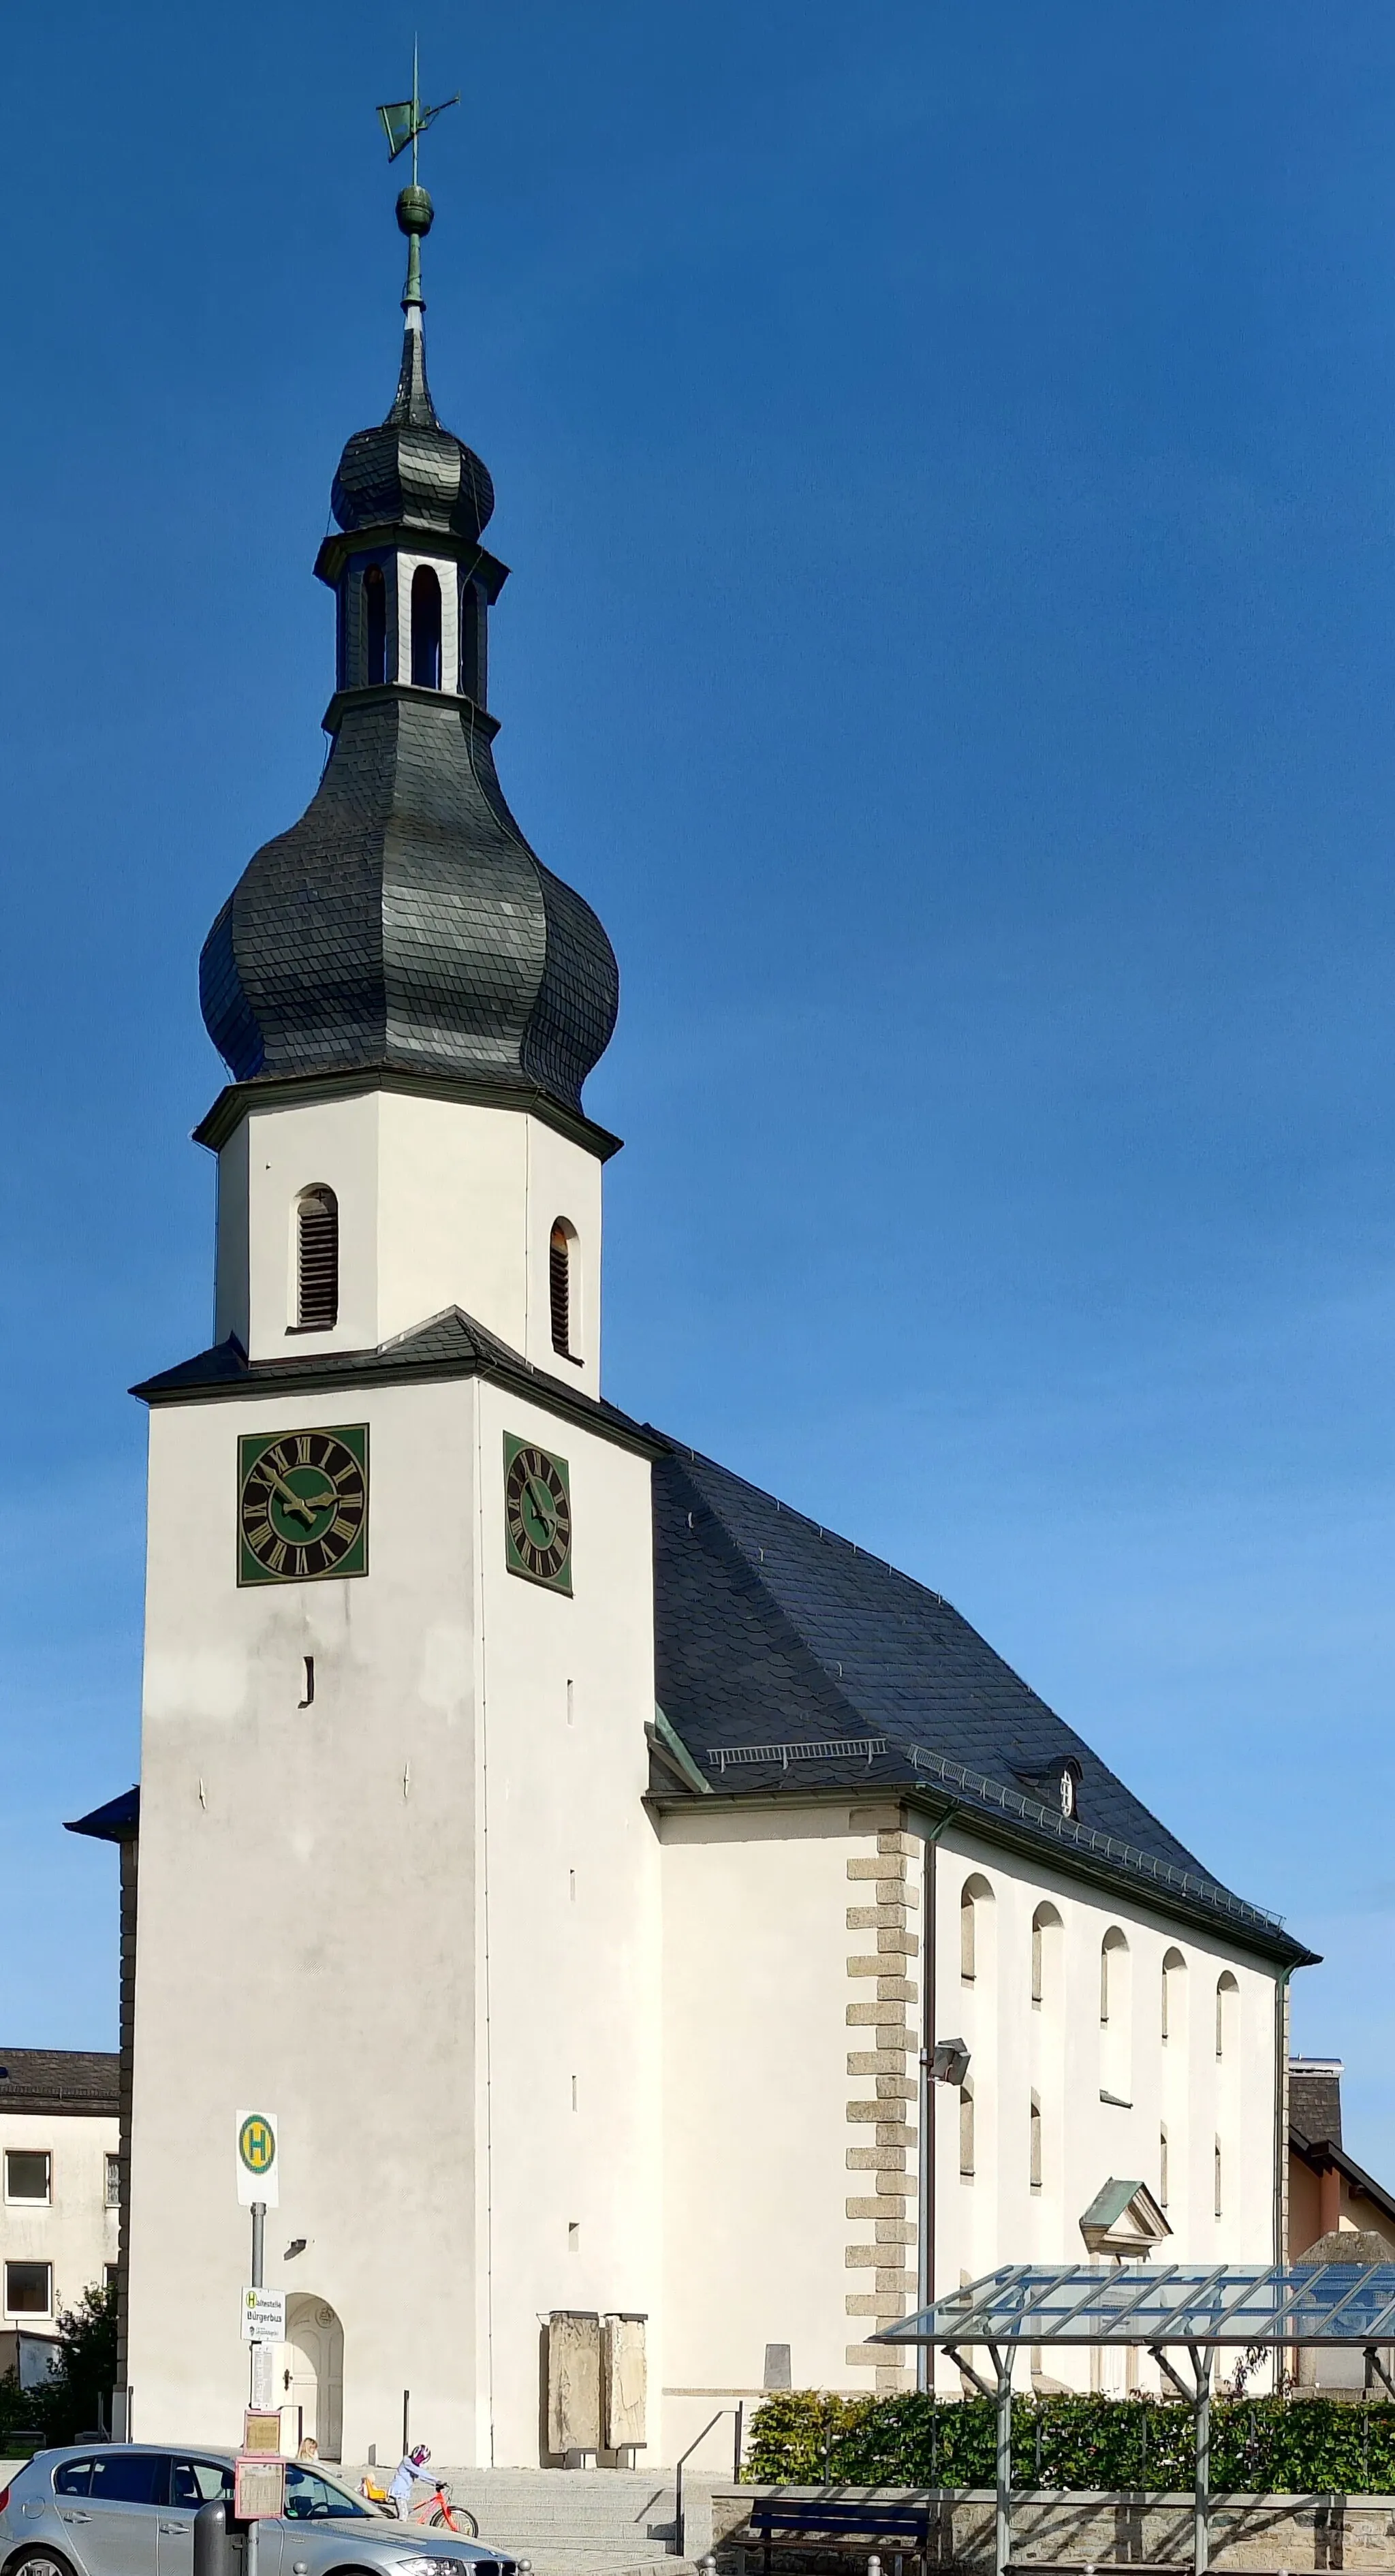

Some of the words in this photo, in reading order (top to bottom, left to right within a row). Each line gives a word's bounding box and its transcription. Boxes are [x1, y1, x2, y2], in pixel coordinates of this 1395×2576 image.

[268, 1445, 291, 1474] XI
[294, 1436, 312, 1464] XII
[318, 1441, 336, 1469] I
[249, 1471, 275, 1492] X
[332, 1460, 358, 1487] II
[243, 1500, 267, 1520] IX
[339, 1490, 362, 1510] III
[247, 1521, 273, 1554] VIII
[330, 1516, 358, 1545] IIII
[265, 1539, 287, 1572] VII
[294, 1547, 310, 1575] VI
[320, 1539, 339, 1567] V
[249, 2130, 266, 2161] H
[249, 2293, 281, 2308] Haltestelle
